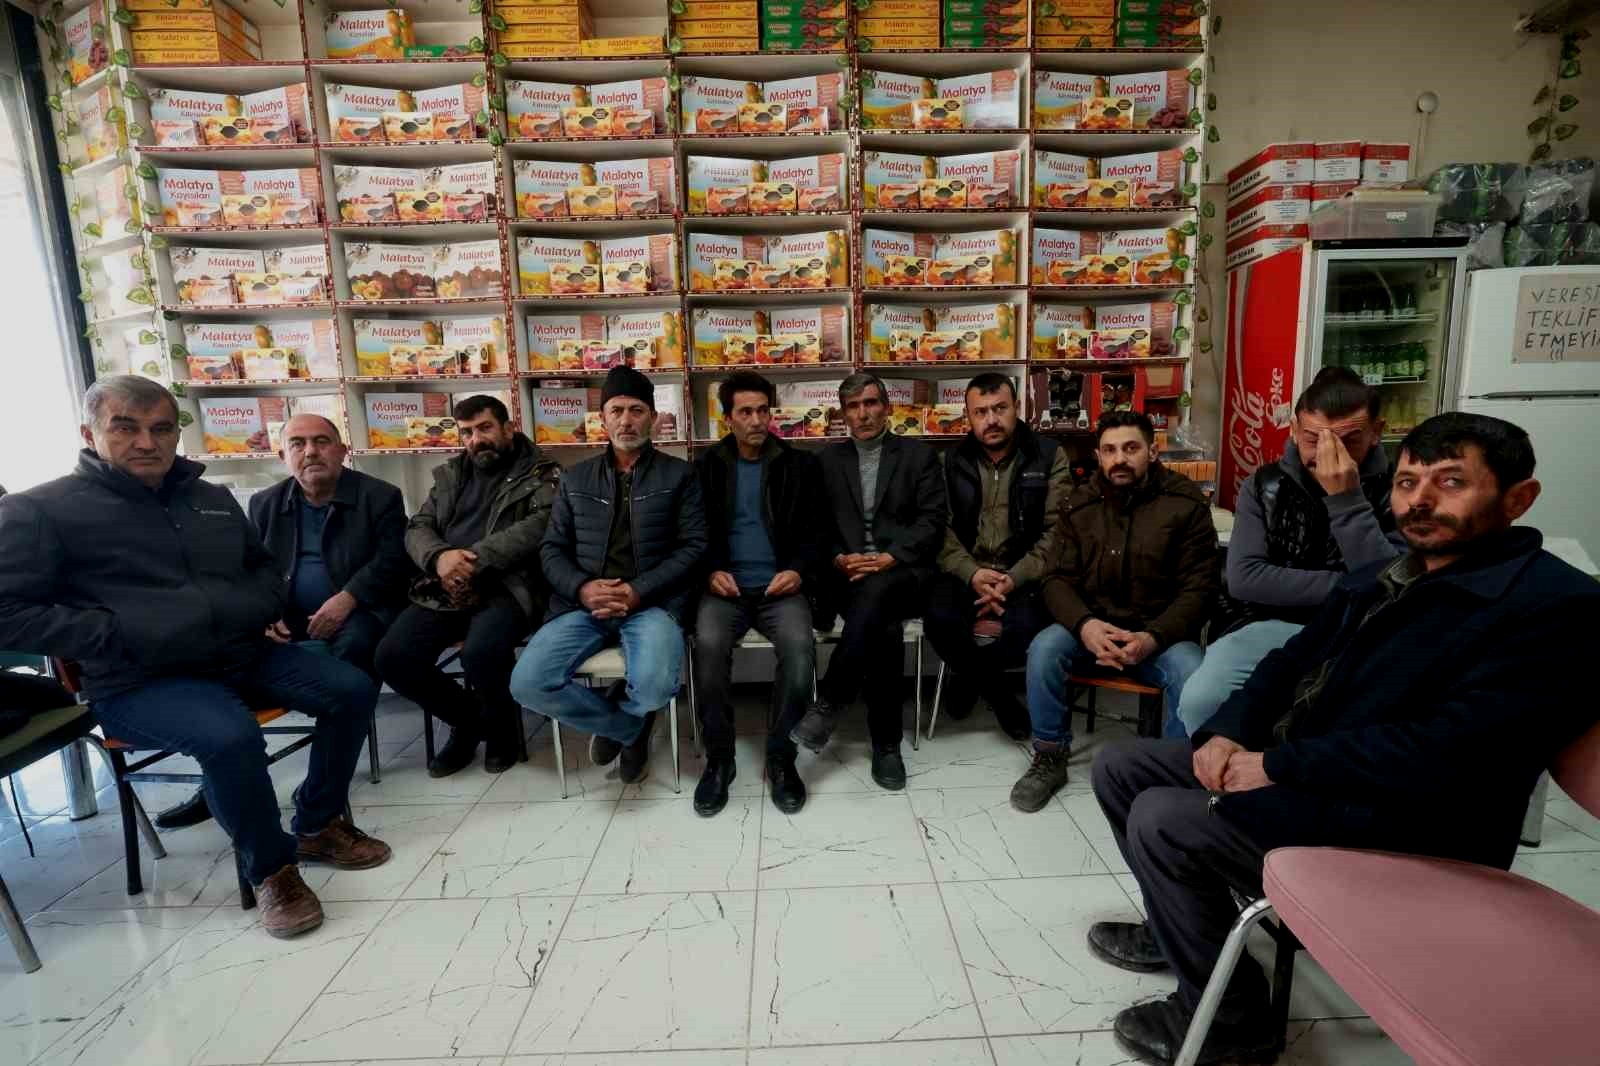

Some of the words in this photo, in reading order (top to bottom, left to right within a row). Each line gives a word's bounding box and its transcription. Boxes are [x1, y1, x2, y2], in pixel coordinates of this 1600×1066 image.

[339, 19, 384, 31] Malatya
[697, 86, 743, 99] Malatya
[877, 79, 920, 95] Malatya
[942, 85, 986, 99] Malatya
[1050, 79, 1091, 93] Malatya
[1115, 82, 1161, 95] Malatya
[344, 93, 396, 107] Malatya
[522, 88, 571, 103] Malatya
[596, 90, 637, 105] Malatya
[769, 88, 811, 102] Malatya
[169, 97, 223, 112] Malatya
[250, 99, 283, 114] Malatya
[421, 96, 459, 112] Malatya
[879, 160, 922, 173] Malatya
[944, 163, 988, 177] Malatya
[1048, 160, 1085, 174] Malatya
[1106, 163, 1152, 177] Malatya
[450, 172, 487, 184] Malatya
[530, 169, 578, 181] Malatya
[601, 170, 643, 182] Malatya
[771, 167, 813, 180] Malatya
[164, 177, 214, 192] Malatya
[253, 179, 295, 191] Malatya
[369, 175, 415, 187] Malatya
[783, 240, 825, 253] Malatya
[872, 239, 910, 252] Malatya
[951, 238, 996, 250] Malatya
[1038, 238, 1076, 250] Malatya
[1118, 235, 1163, 248] Malatya
[534, 246, 581, 257] Malatya
[605, 247, 644, 260] Malatya
[696, 242, 738, 255] Malatya
[207, 257, 255, 268] Malatya
[380, 252, 425, 263] Malatya
[709, 316, 752, 328] Malatya
[884, 311, 922, 324] Malatya
[951, 311, 994, 323] Malatya
[1101, 313, 1145, 326] Malatya
[1528, 306, 1599, 328] TEKLİF
[776, 318, 816, 330] Malatya
[202, 330, 252, 342] Malatya
[371, 326, 421, 338] Malatya
[533, 324, 576, 338] Malatya
[886, 389, 911, 400] alatya
[943, 388, 966, 399] Mala
[372, 400, 418, 413] Malatya
[539, 397, 583, 409] Malatya
[207, 407, 254, 419] Malatya
